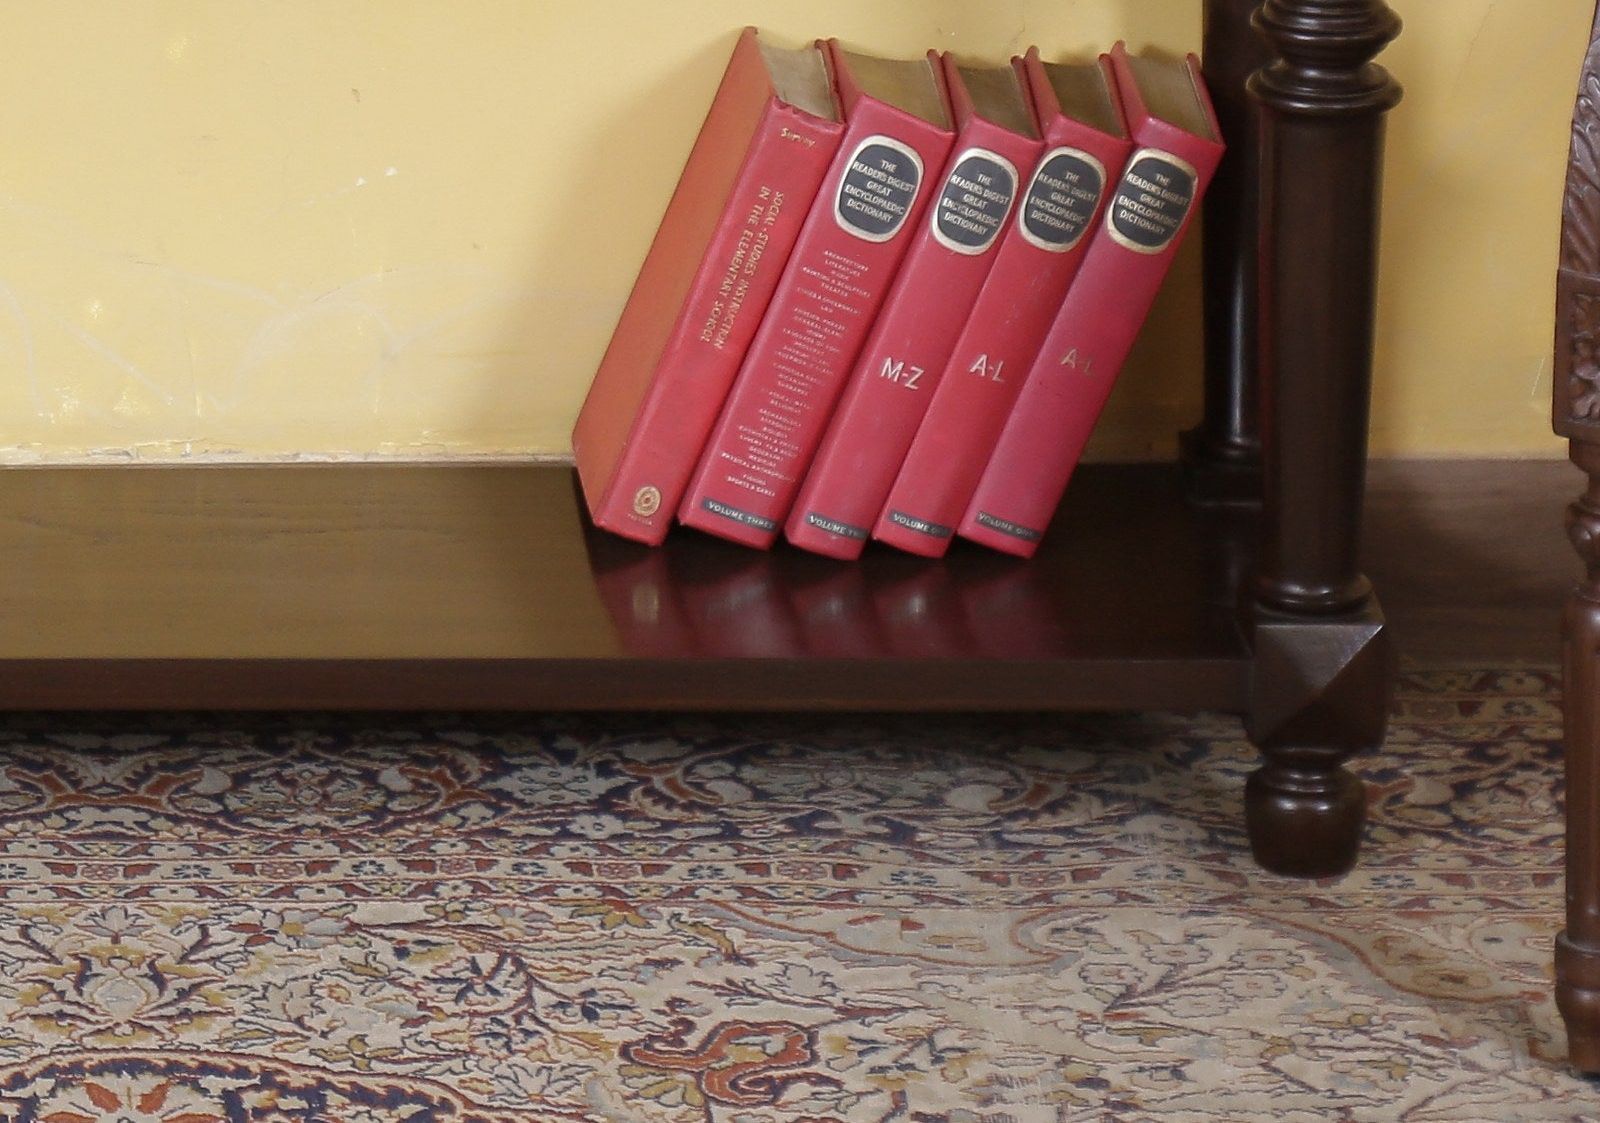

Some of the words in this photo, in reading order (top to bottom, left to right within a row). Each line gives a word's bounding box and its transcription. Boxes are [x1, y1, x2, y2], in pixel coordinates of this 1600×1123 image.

[881, 159, 898, 173] THE
[887, 176, 916, 193] DIGEST
[977, 173, 993, 186] THE
[1065, 171, 1081, 183] THE
[1155, 173, 1172, 187] THE
[866, 180, 893, 197] GREAT
[846, 198, 893, 223] DICTIONARY
[963, 193, 988, 210] GREAT
[1140, 193, 1166, 210] GREAT
[747, 204, 764, 225] THE
[943, 211, 989, 235] DICTIONARY
[1031, 209, 1075, 233] DICTIONARY
[1119, 209, 1165, 235] DICTIONARY
[719, 229, 754, 298] ELEMENTARY
[881, 357, 925, 390] M-Z
[969, 354, 1004, 383] A-L
[708, 501, 744, 521] VOLUME
[809, 514, 847, 534] VOLUME
[893, 512, 930, 532] VOLUME
[978, 512, 1014, 532] VOLUME
